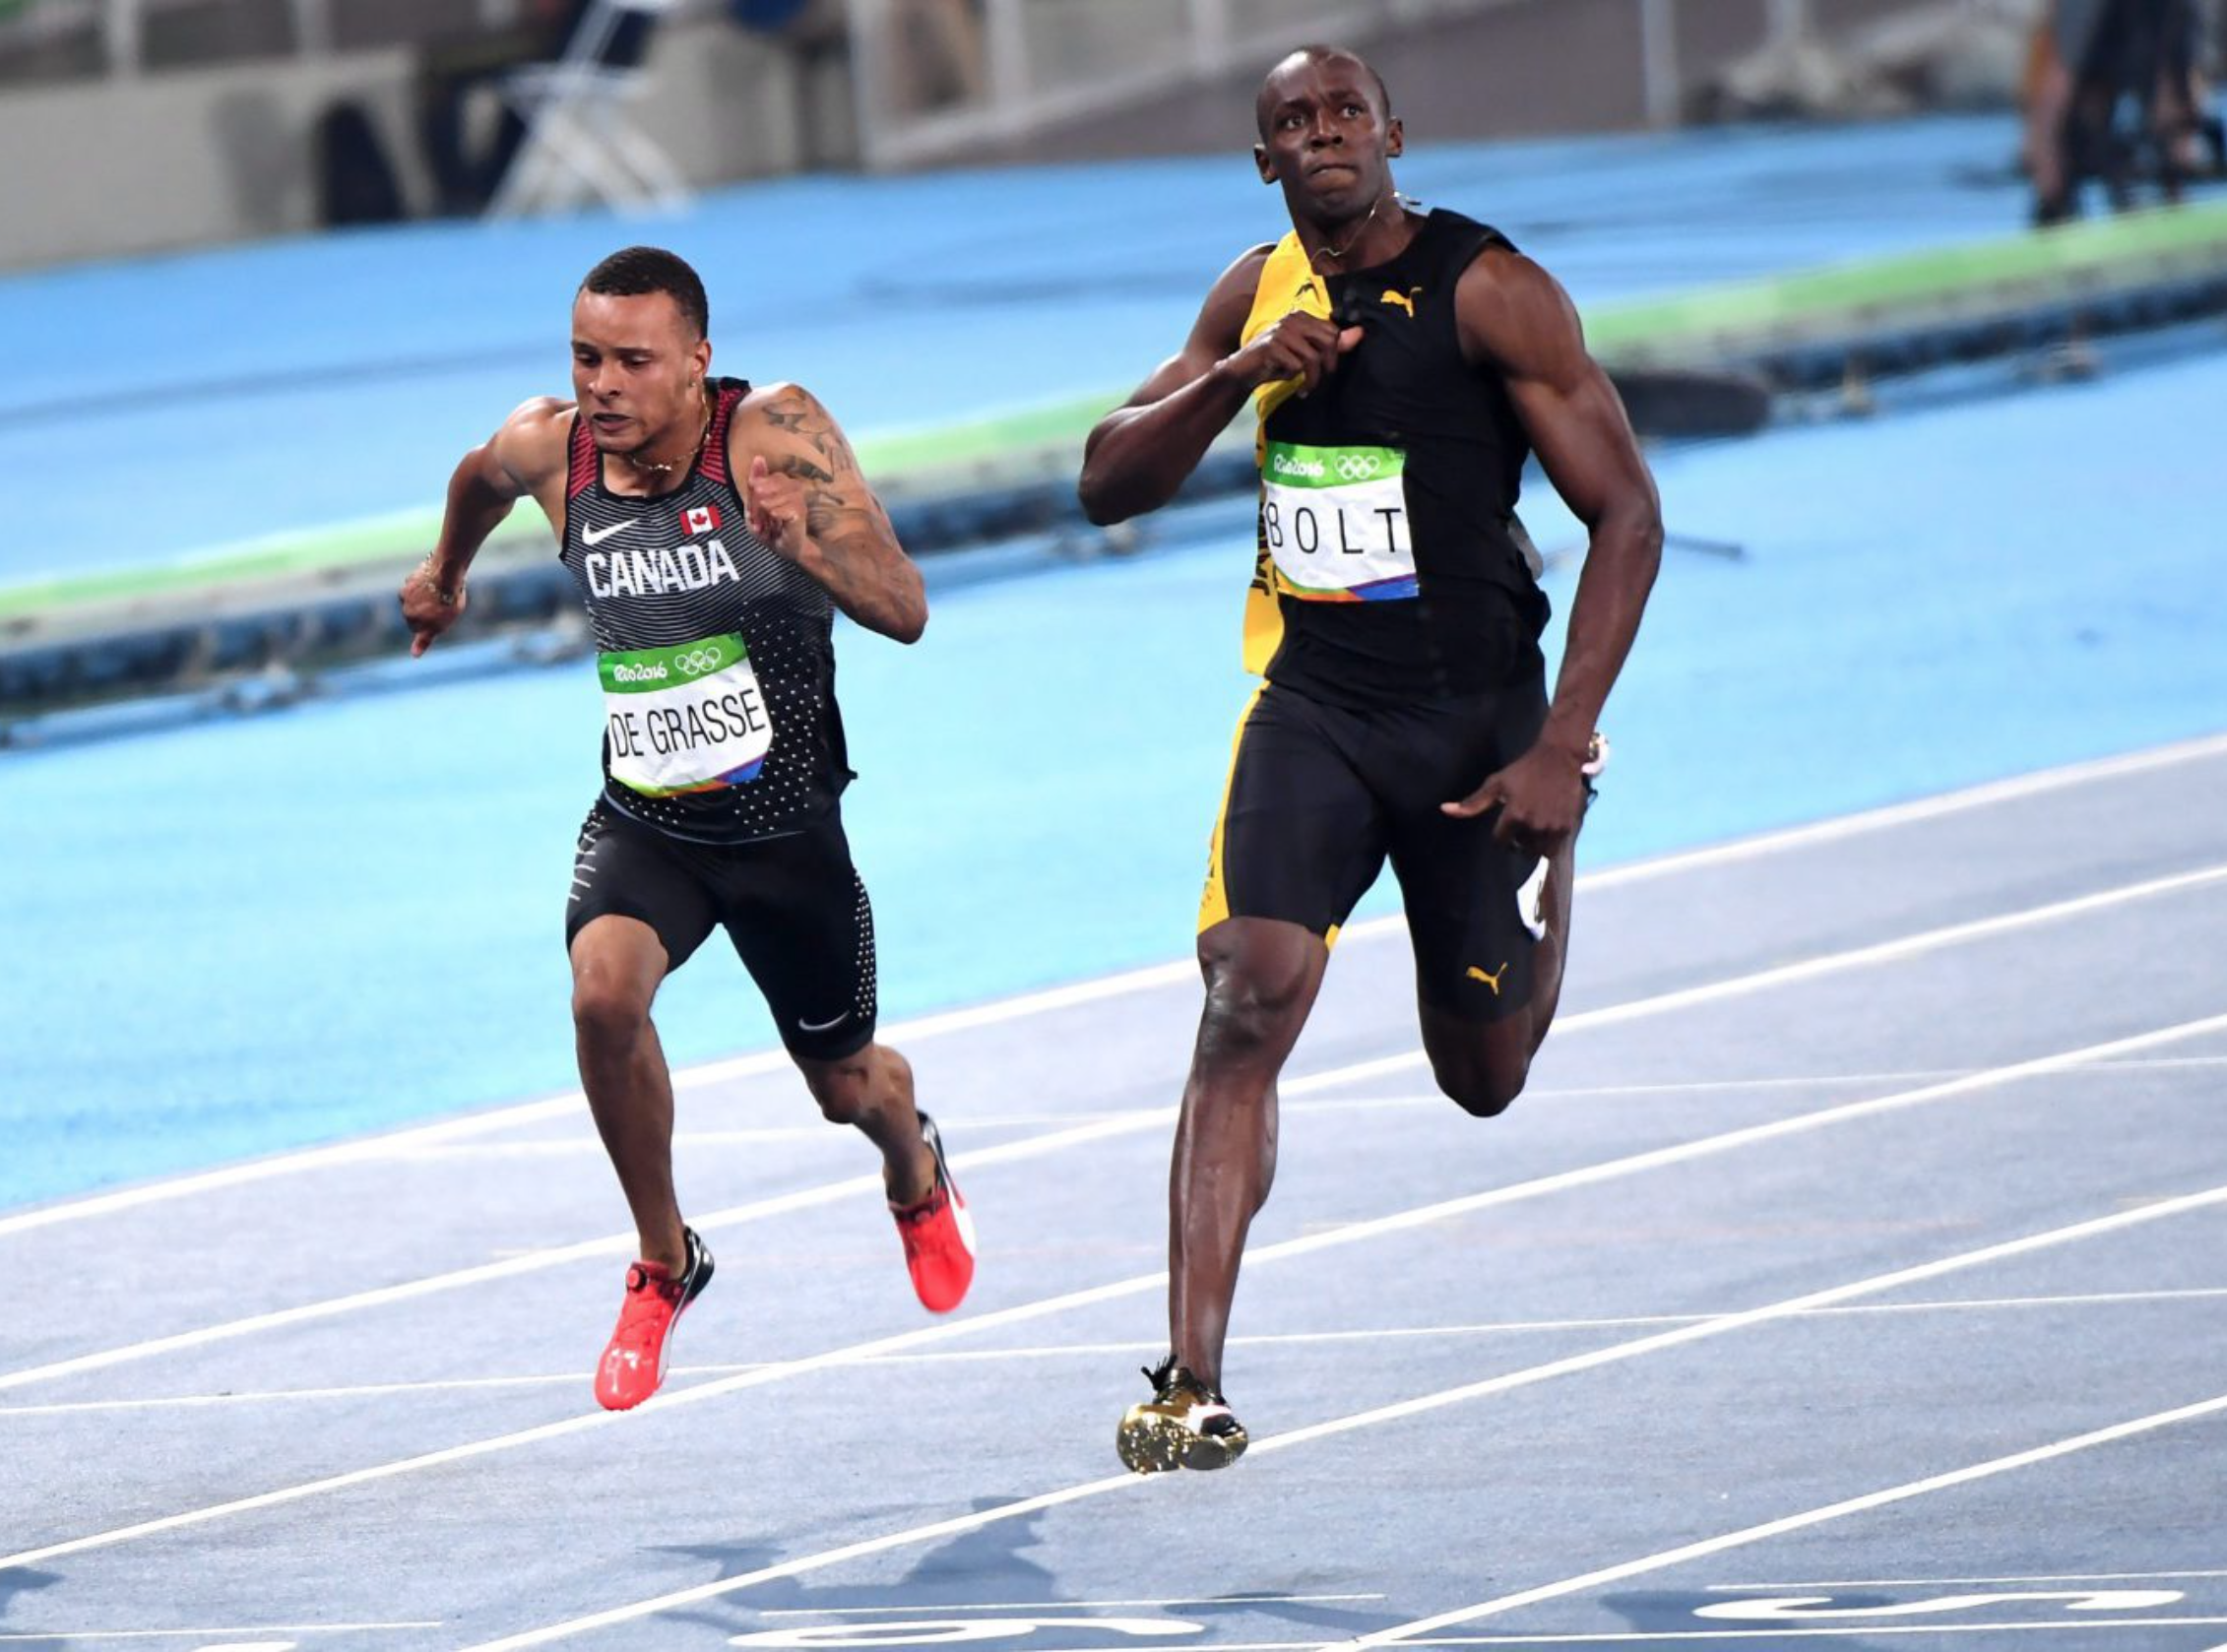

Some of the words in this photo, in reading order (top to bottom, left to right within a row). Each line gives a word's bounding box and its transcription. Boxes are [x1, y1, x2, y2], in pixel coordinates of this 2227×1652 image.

[1265, 501, 1402, 554] BOLT
[585, 540, 739, 599] CANADA
[610, 712, 644, 758] DE
[646, 688, 766, 754] GRASSE
